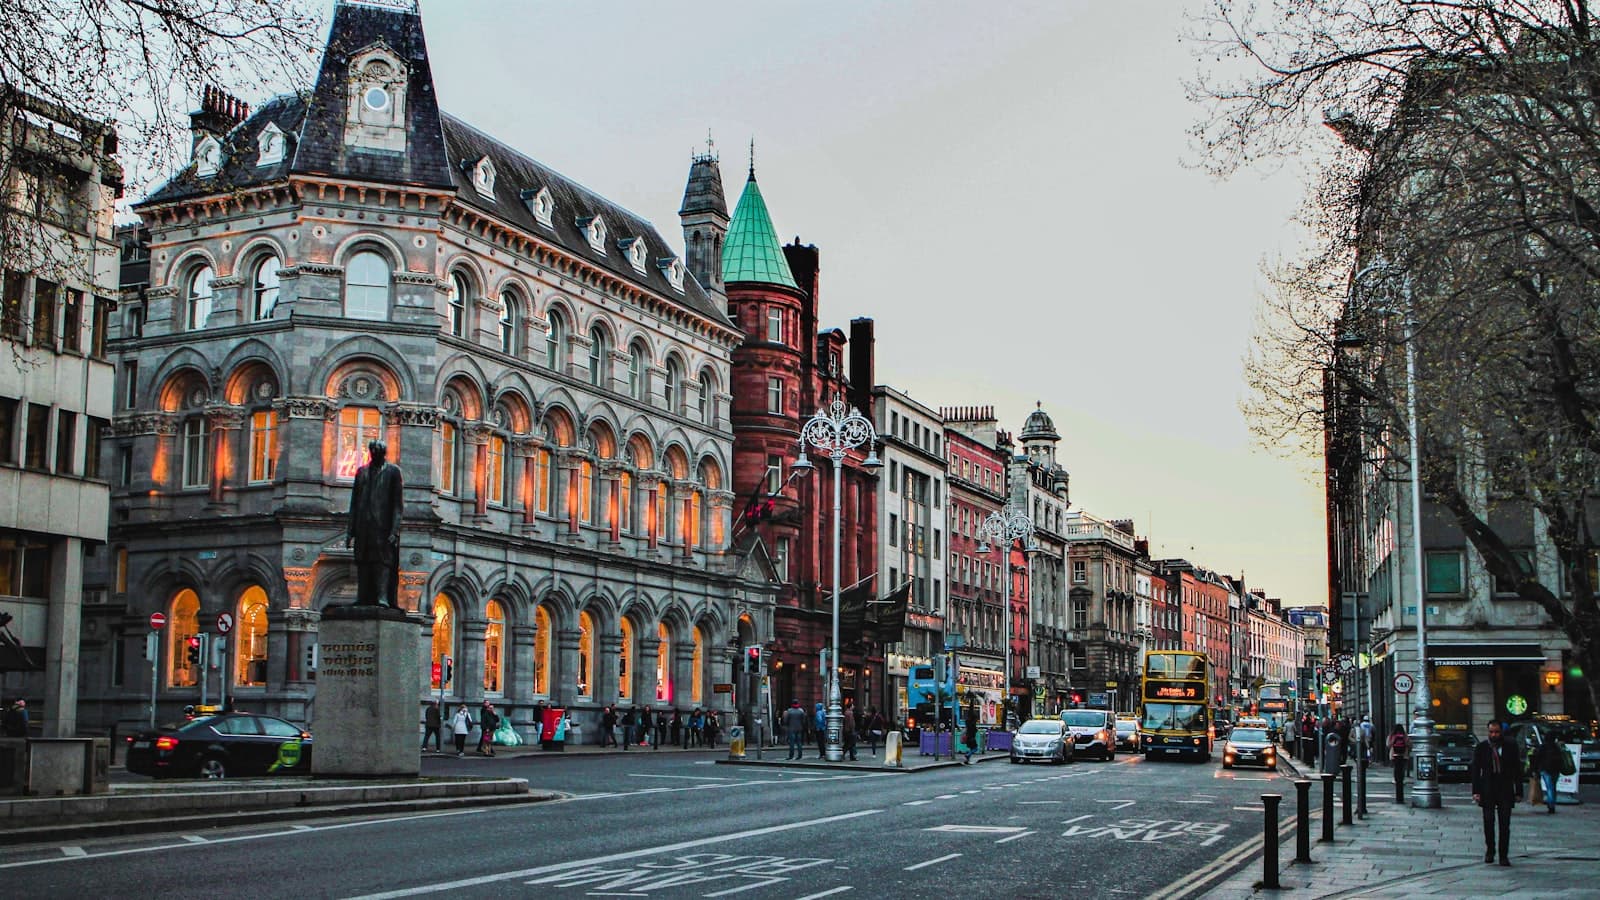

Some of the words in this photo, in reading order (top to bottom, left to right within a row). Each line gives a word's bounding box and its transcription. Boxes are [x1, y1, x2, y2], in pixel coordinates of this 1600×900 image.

[1187, 688, 1196, 697] 79
[1108, 819, 1231, 834] BUS
[636, 853, 835, 875] BUS
